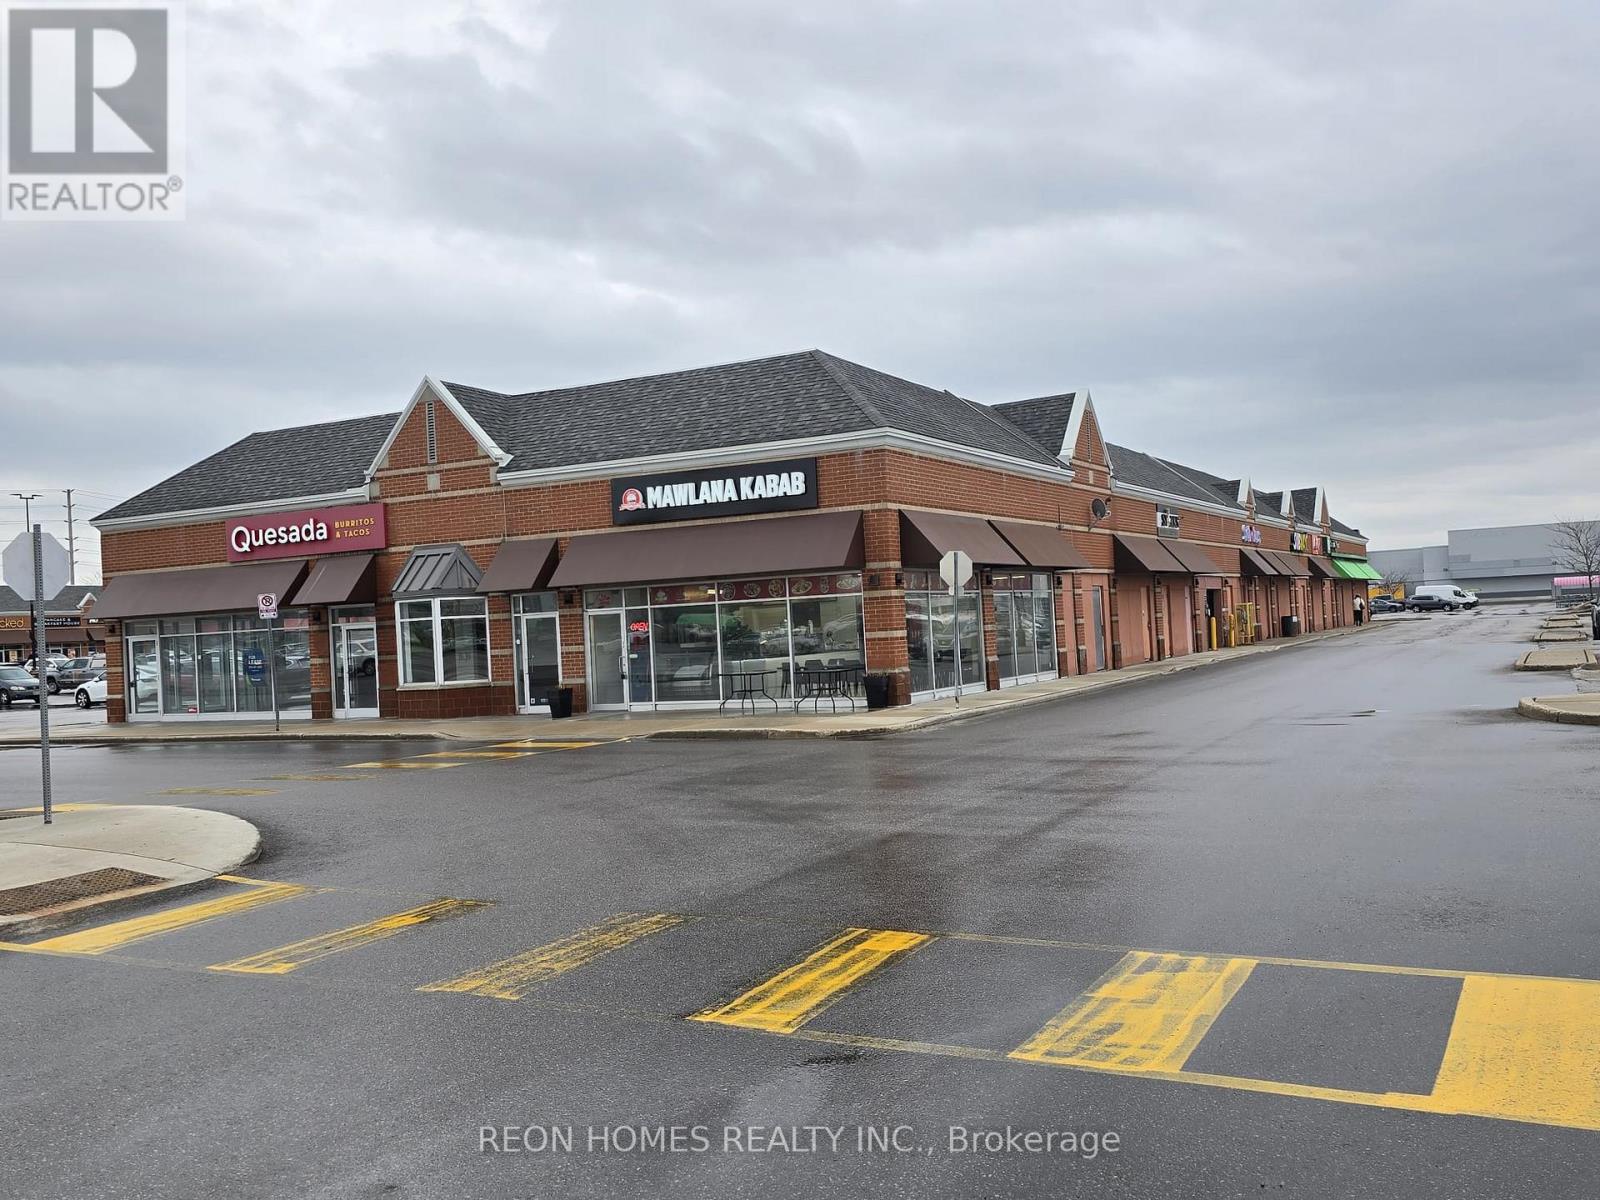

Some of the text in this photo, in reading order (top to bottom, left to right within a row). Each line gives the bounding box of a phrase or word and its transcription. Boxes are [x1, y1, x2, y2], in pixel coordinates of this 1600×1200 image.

[646, 471, 806, 509] MAWLANA KABAB
[334, 517, 375, 529] BURRITOS
[231, 518, 328, 553] Quesada
[344, 528, 370, 538] TACOS
[630, 621, 649, 631] OPEN
